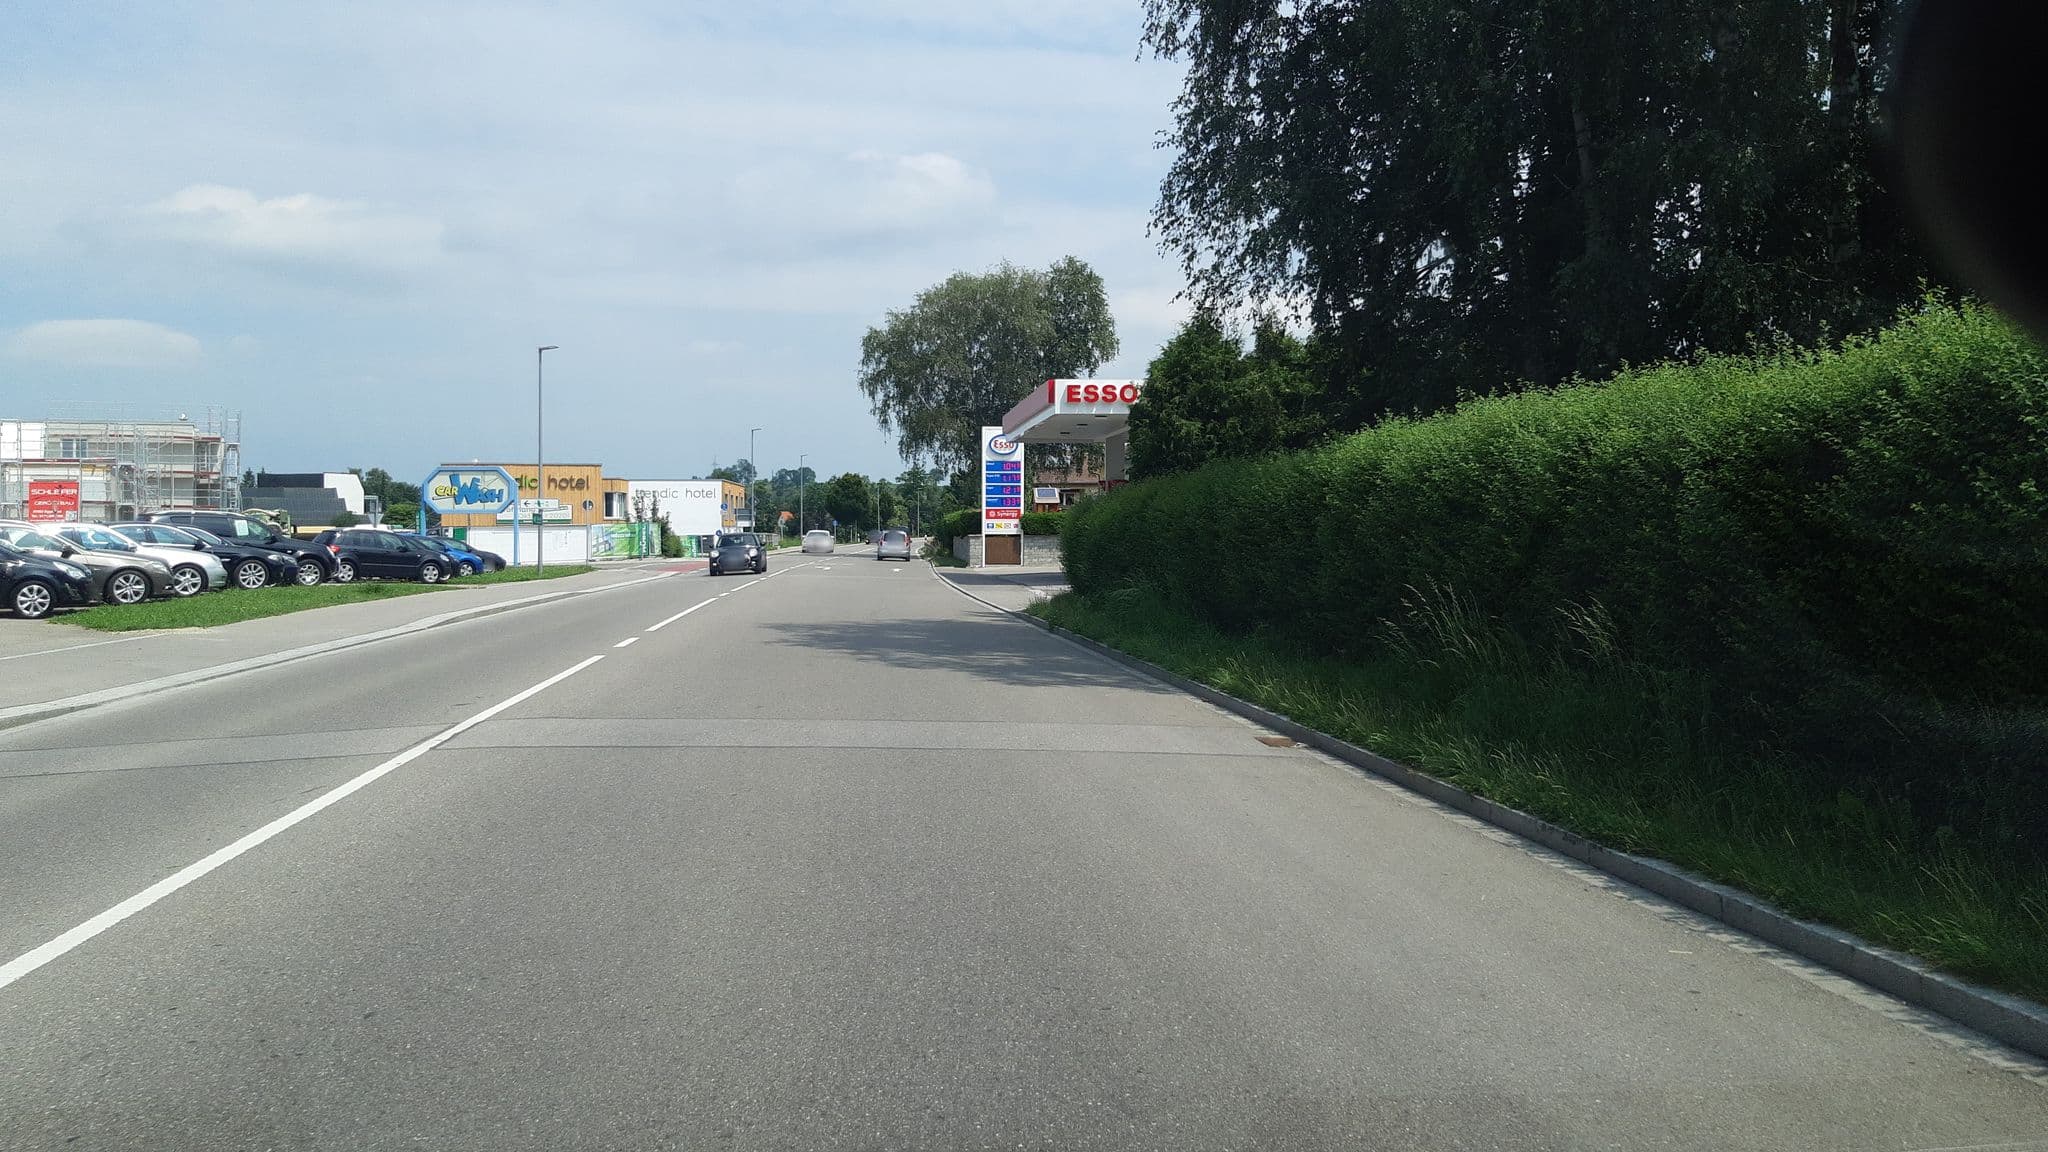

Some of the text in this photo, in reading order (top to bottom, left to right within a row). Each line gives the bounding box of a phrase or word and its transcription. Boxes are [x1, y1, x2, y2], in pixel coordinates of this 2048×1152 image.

[1066, 384, 1138, 403] ESSO
[993, 439, 1015, 449] Esso
[547, 474, 590, 490] hotel
[434, 485, 459, 496] CAR
[635, 487, 717, 499] trendic hotel
